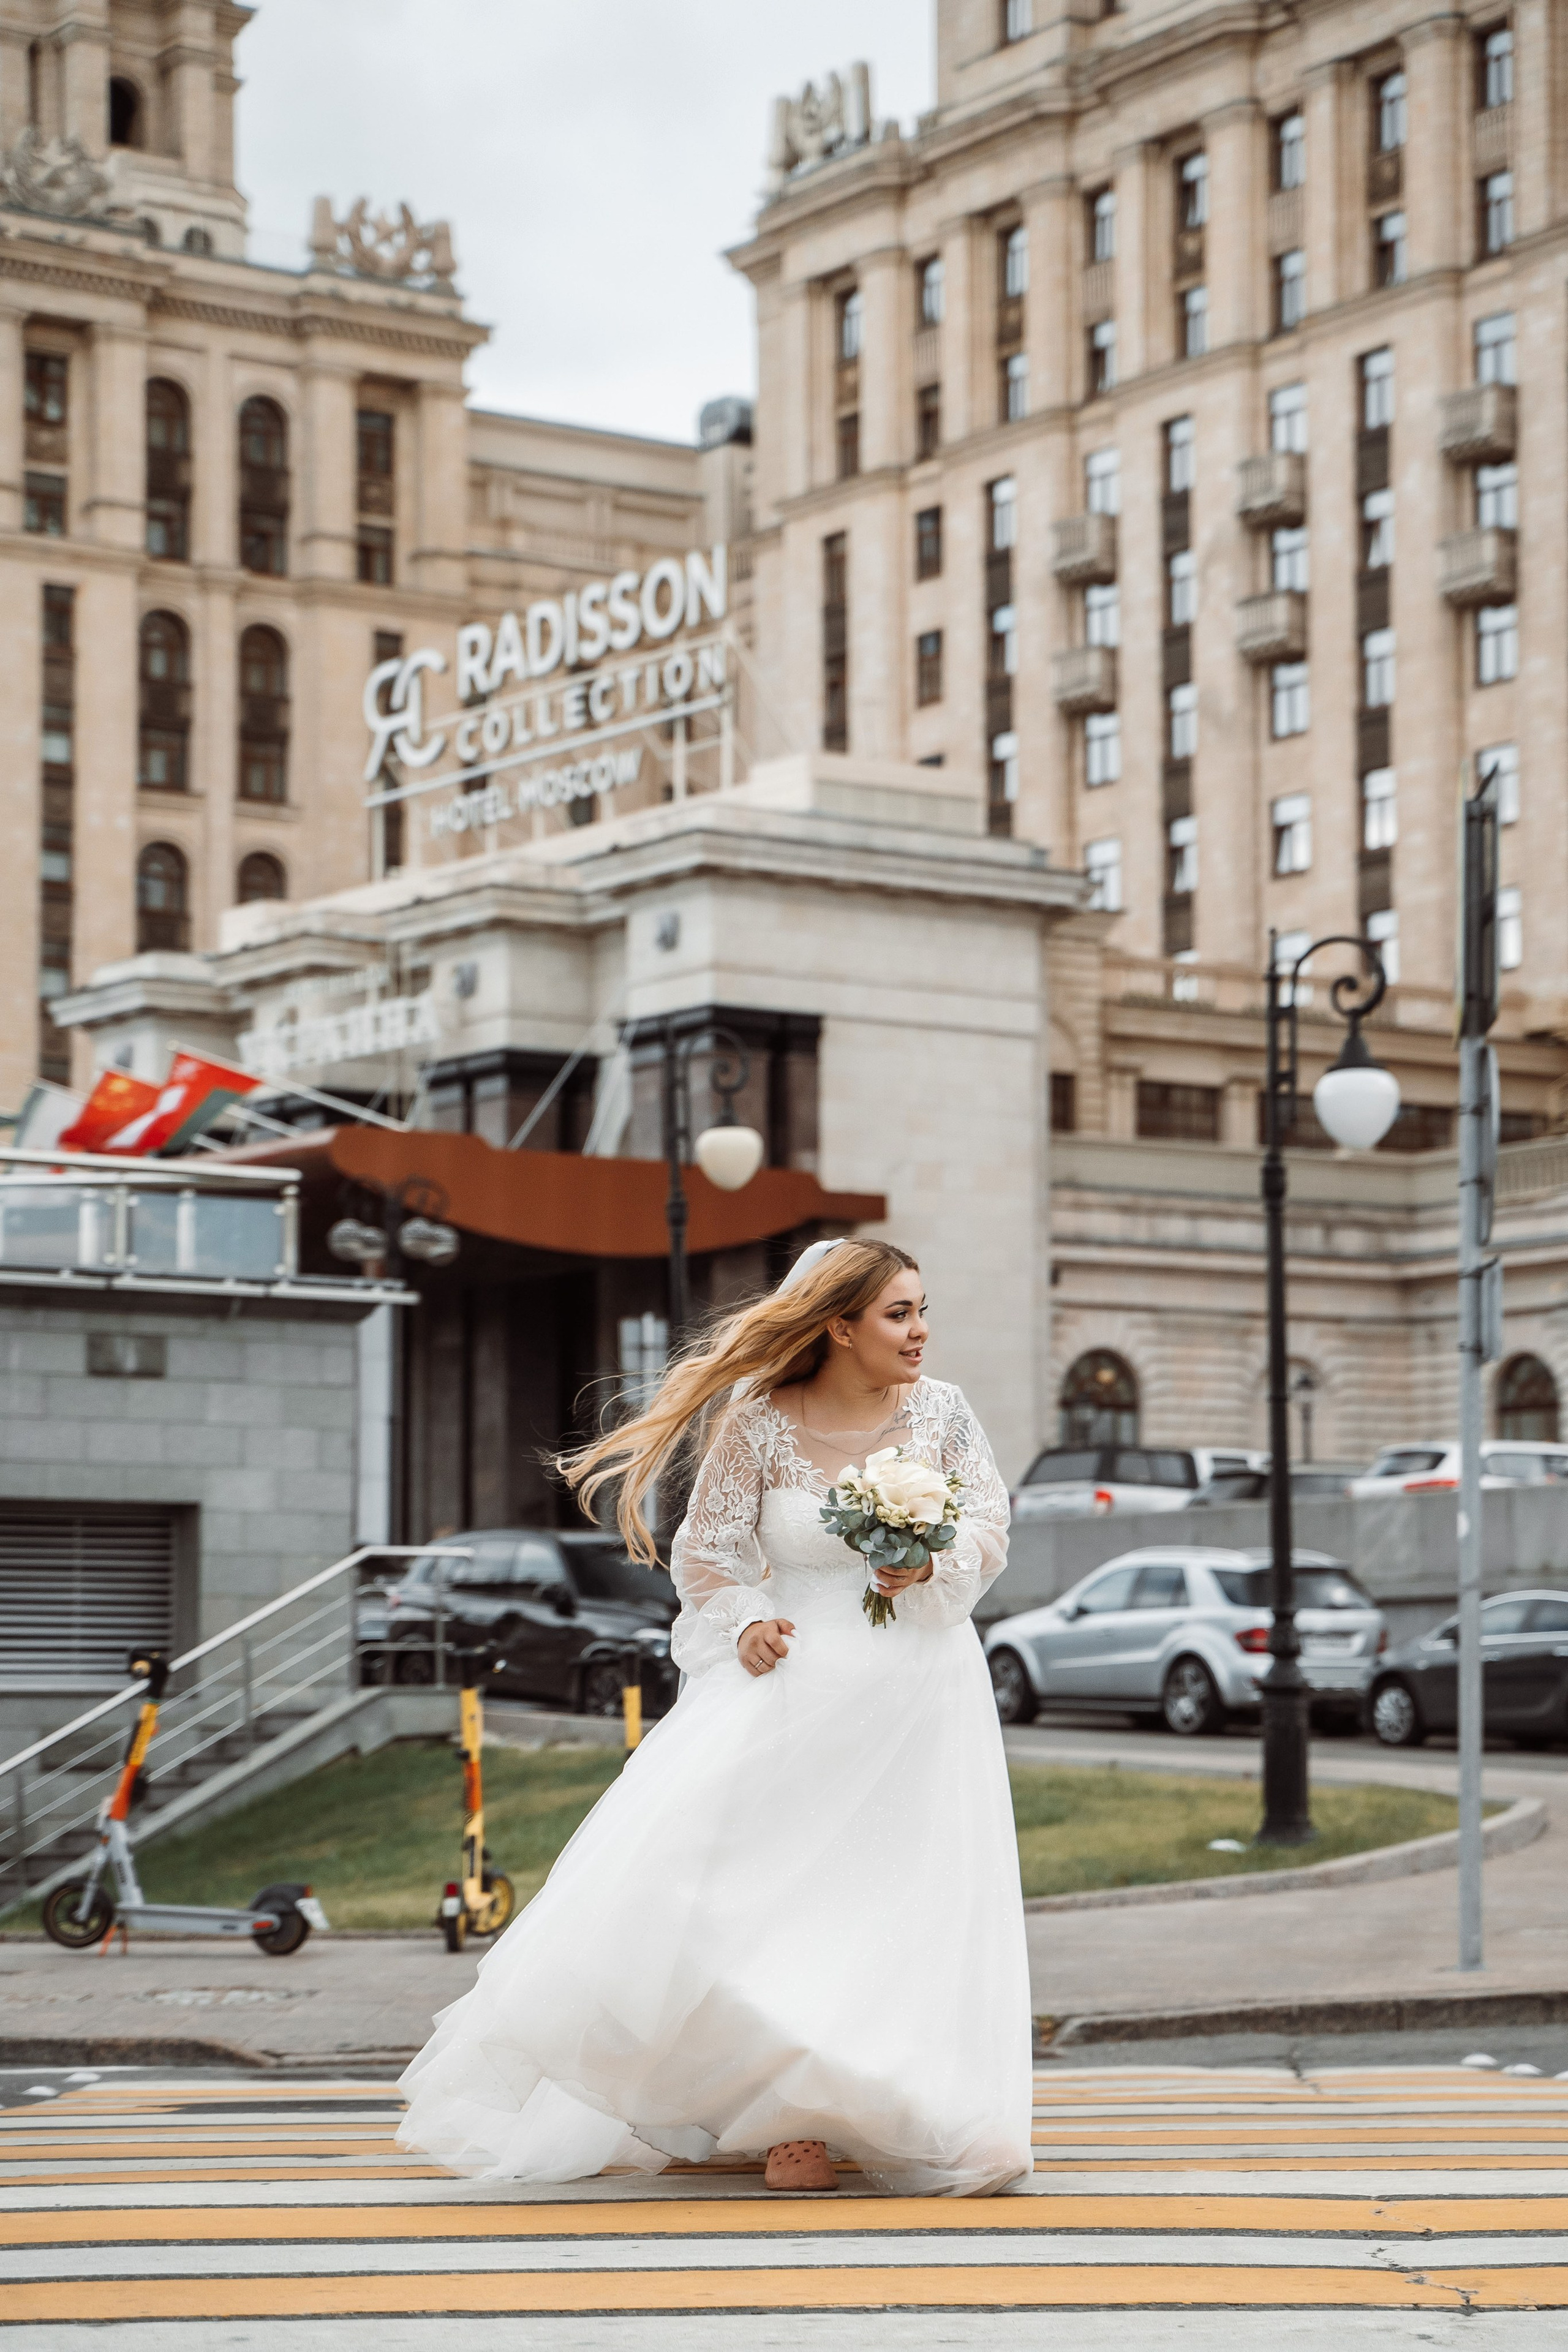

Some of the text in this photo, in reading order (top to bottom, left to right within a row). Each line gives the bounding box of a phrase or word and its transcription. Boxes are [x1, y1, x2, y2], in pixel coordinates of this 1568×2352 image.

[457, 543, 728, 699] RADISSON
[456, 642, 726, 762] COLLECTION
[430, 747, 643, 837] HOTEL MOSCOW
